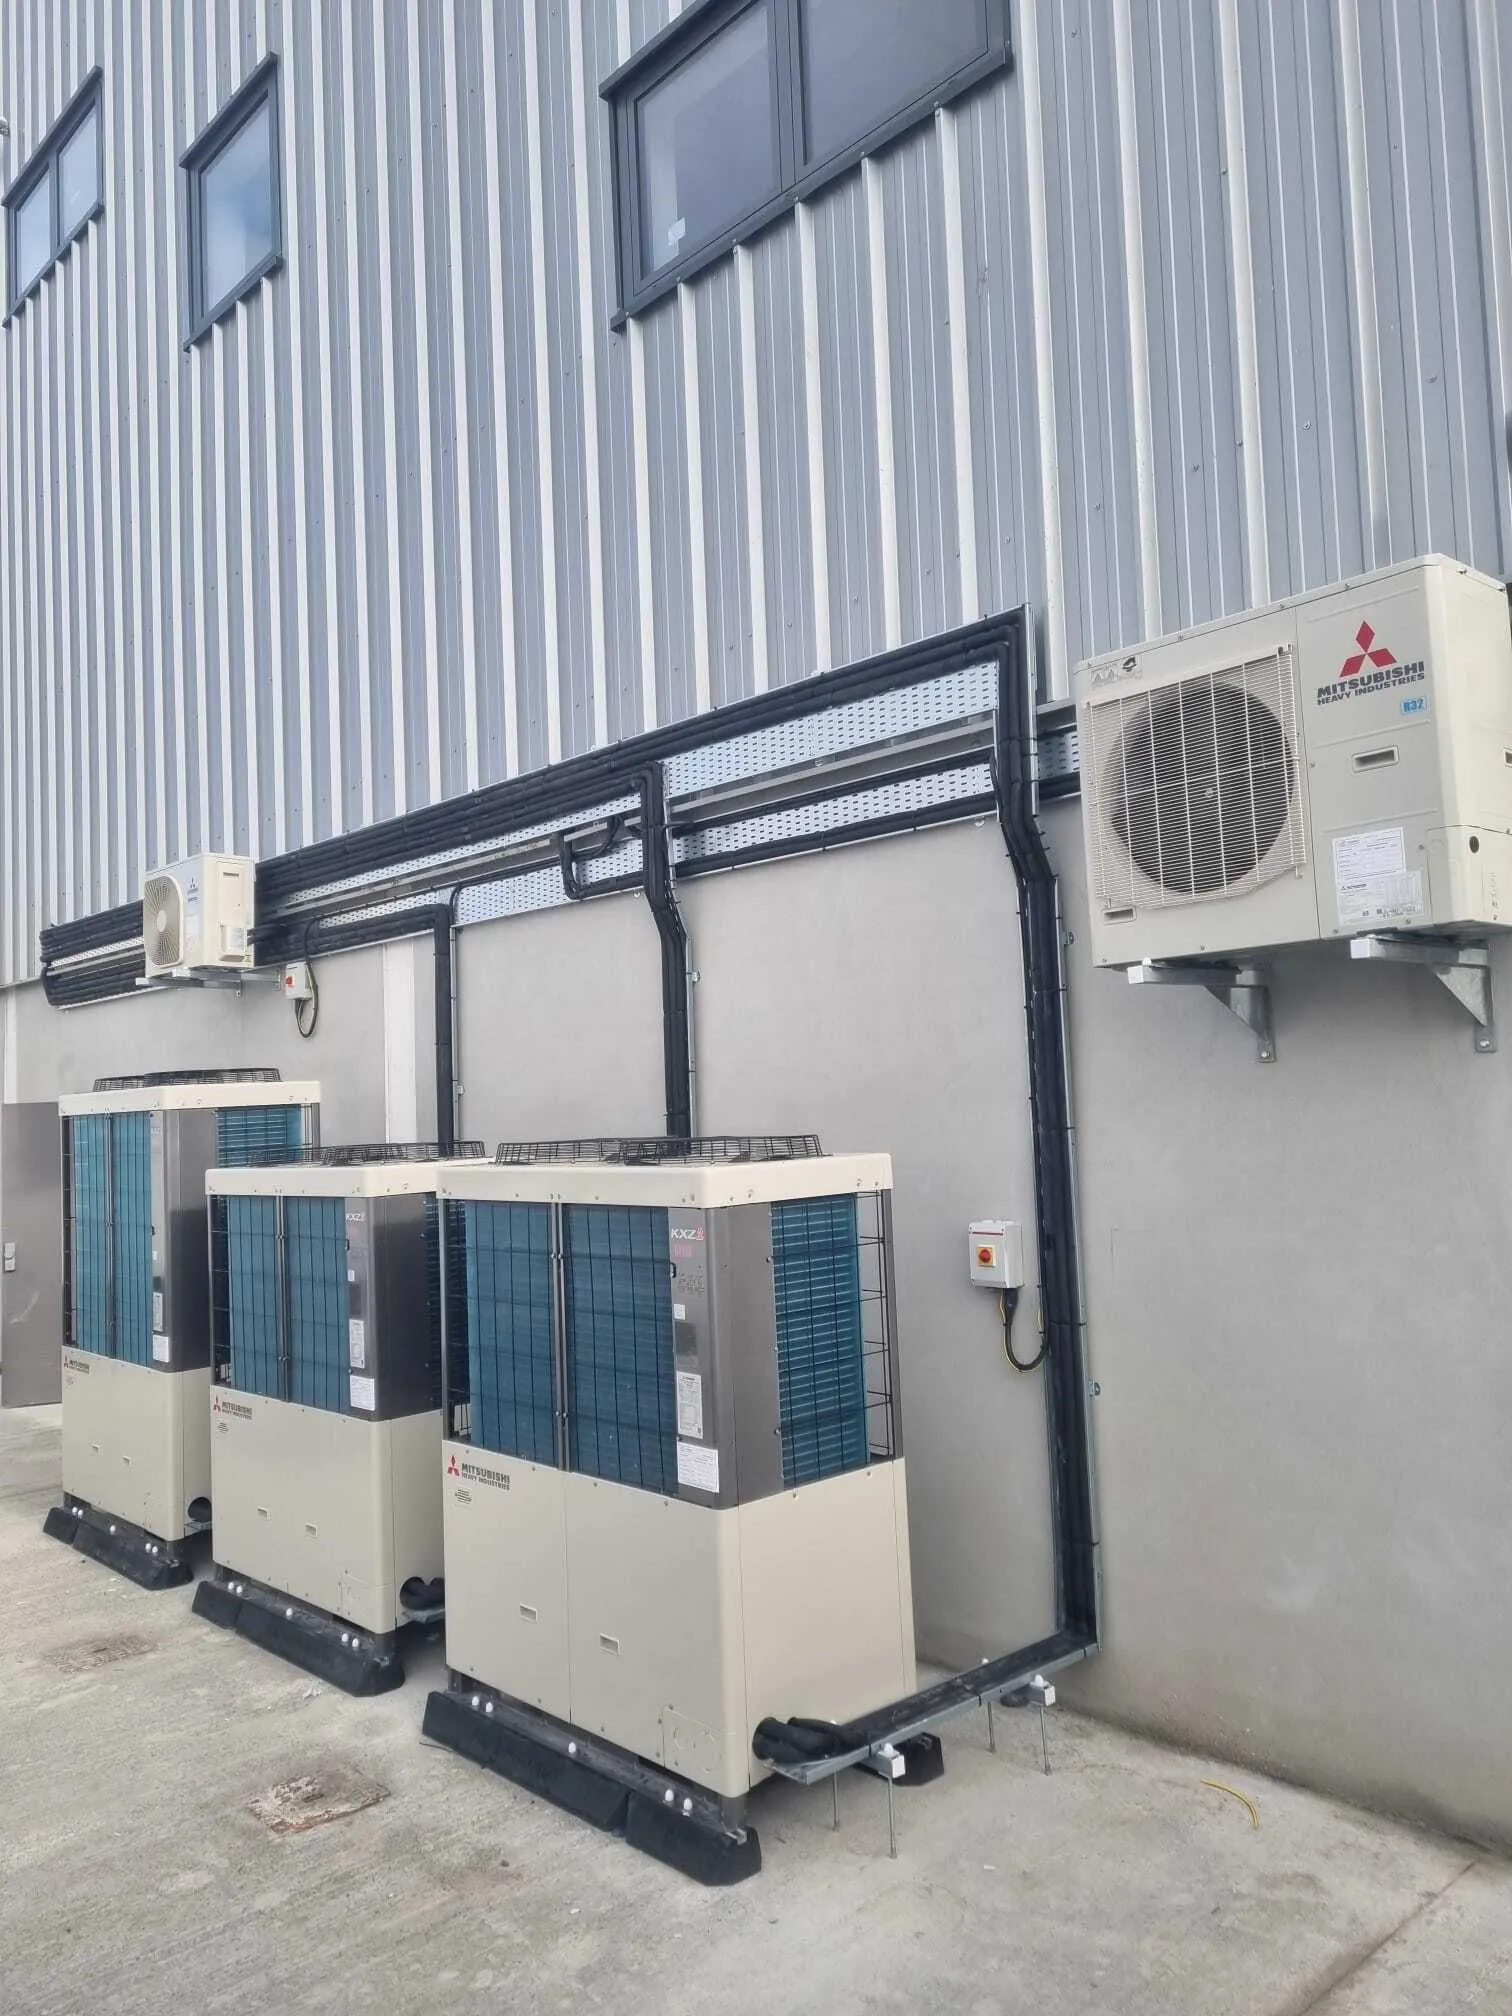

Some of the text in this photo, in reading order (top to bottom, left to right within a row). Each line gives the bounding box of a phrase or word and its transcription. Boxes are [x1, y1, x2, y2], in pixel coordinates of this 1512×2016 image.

[1317, 661, 1425, 698] MITSUBISHI
[1317, 672, 1425, 706] HEAVY INDUSTRIES
[1403, 699, 1424, 713] R32
[461, 1463, 510, 1485] MITSUBISHI
